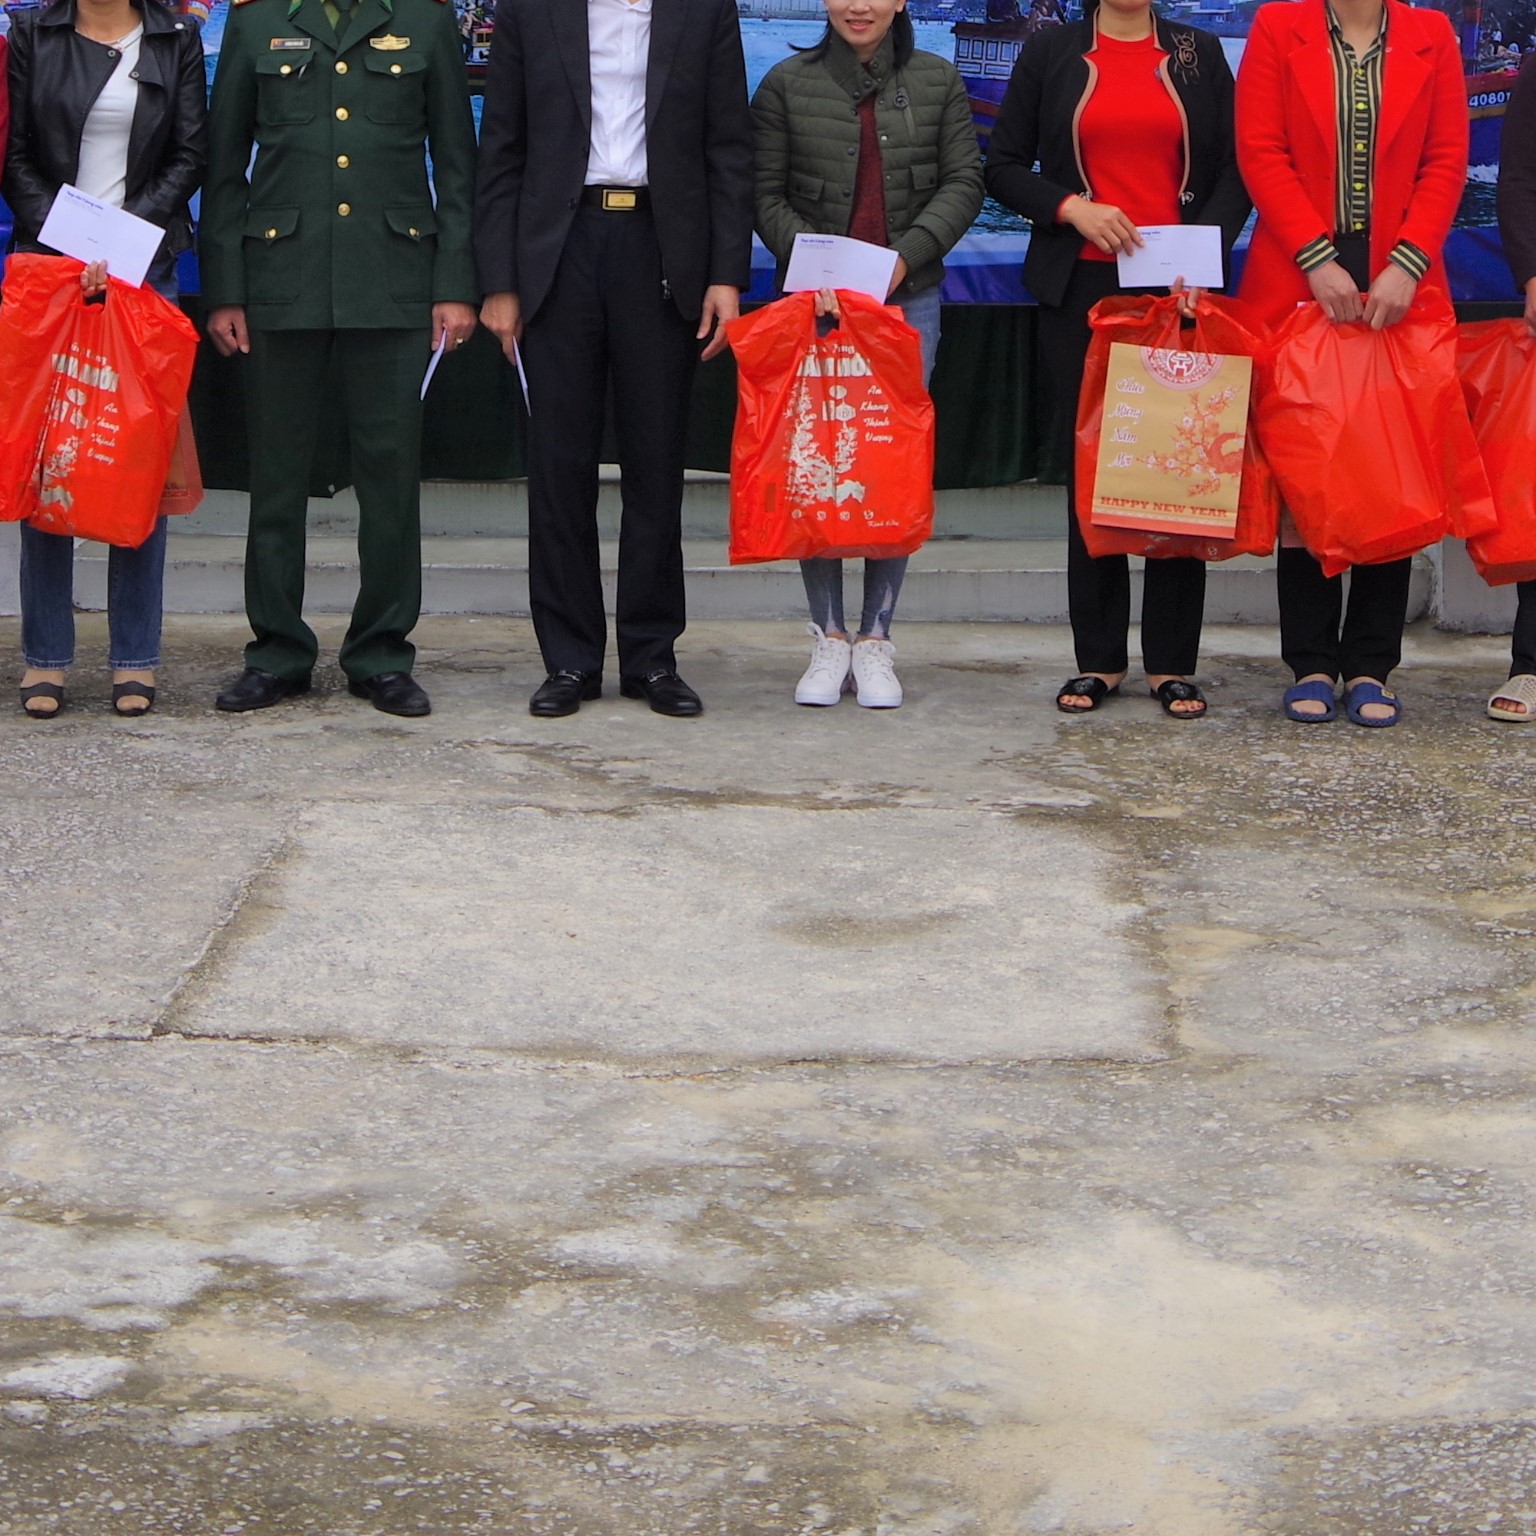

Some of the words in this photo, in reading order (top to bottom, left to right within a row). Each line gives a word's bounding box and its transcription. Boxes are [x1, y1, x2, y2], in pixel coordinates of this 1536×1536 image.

[1100, 496, 1149, 511] HAPPY
[1153, 501, 1186, 514] NEW
[1190, 505, 1228, 518] YEAR
